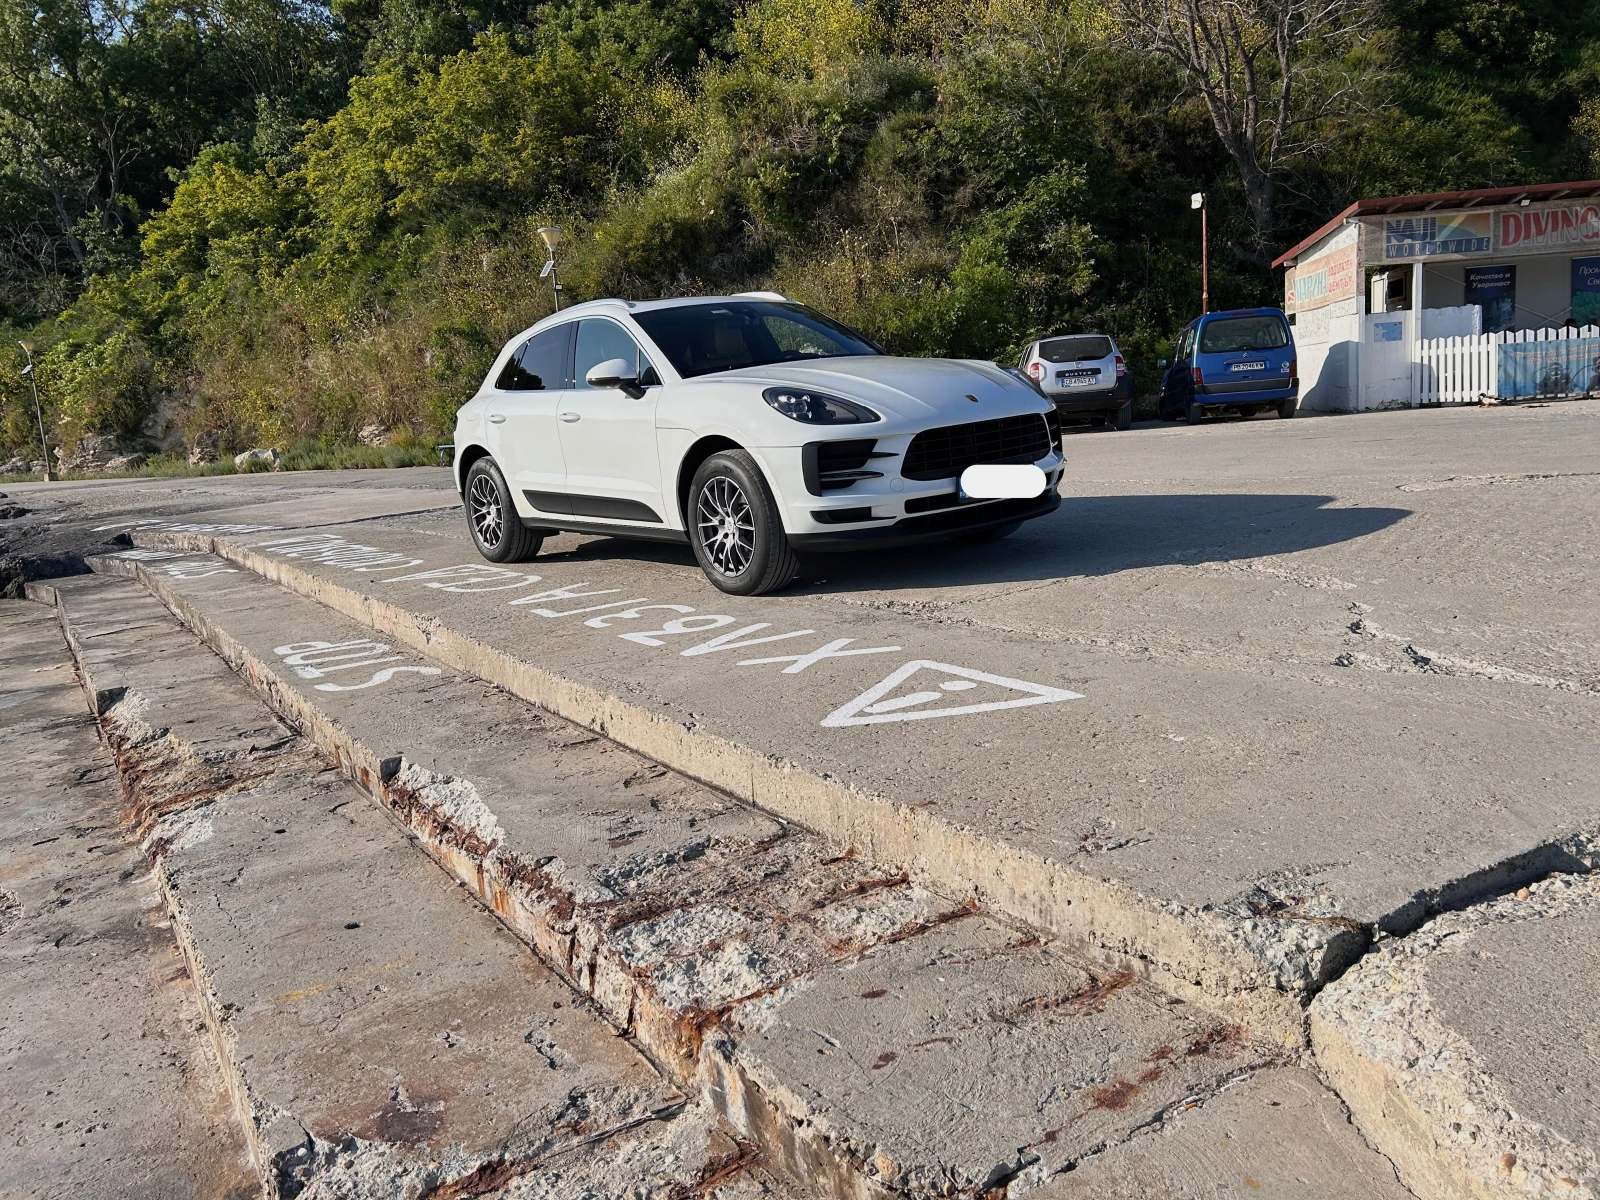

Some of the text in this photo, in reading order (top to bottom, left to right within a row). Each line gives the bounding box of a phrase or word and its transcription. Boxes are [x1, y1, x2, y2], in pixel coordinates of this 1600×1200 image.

[1386, 216, 1437, 244] NAUI
[1500, 205, 1600, 247] DIVING
[1388, 239, 1489, 258] WORLDWIDE
[1469, 272, 1504, 281] Качество
[1471, 280, 1511, 289] Увереност
[273, 638, 442, 692] STOP
